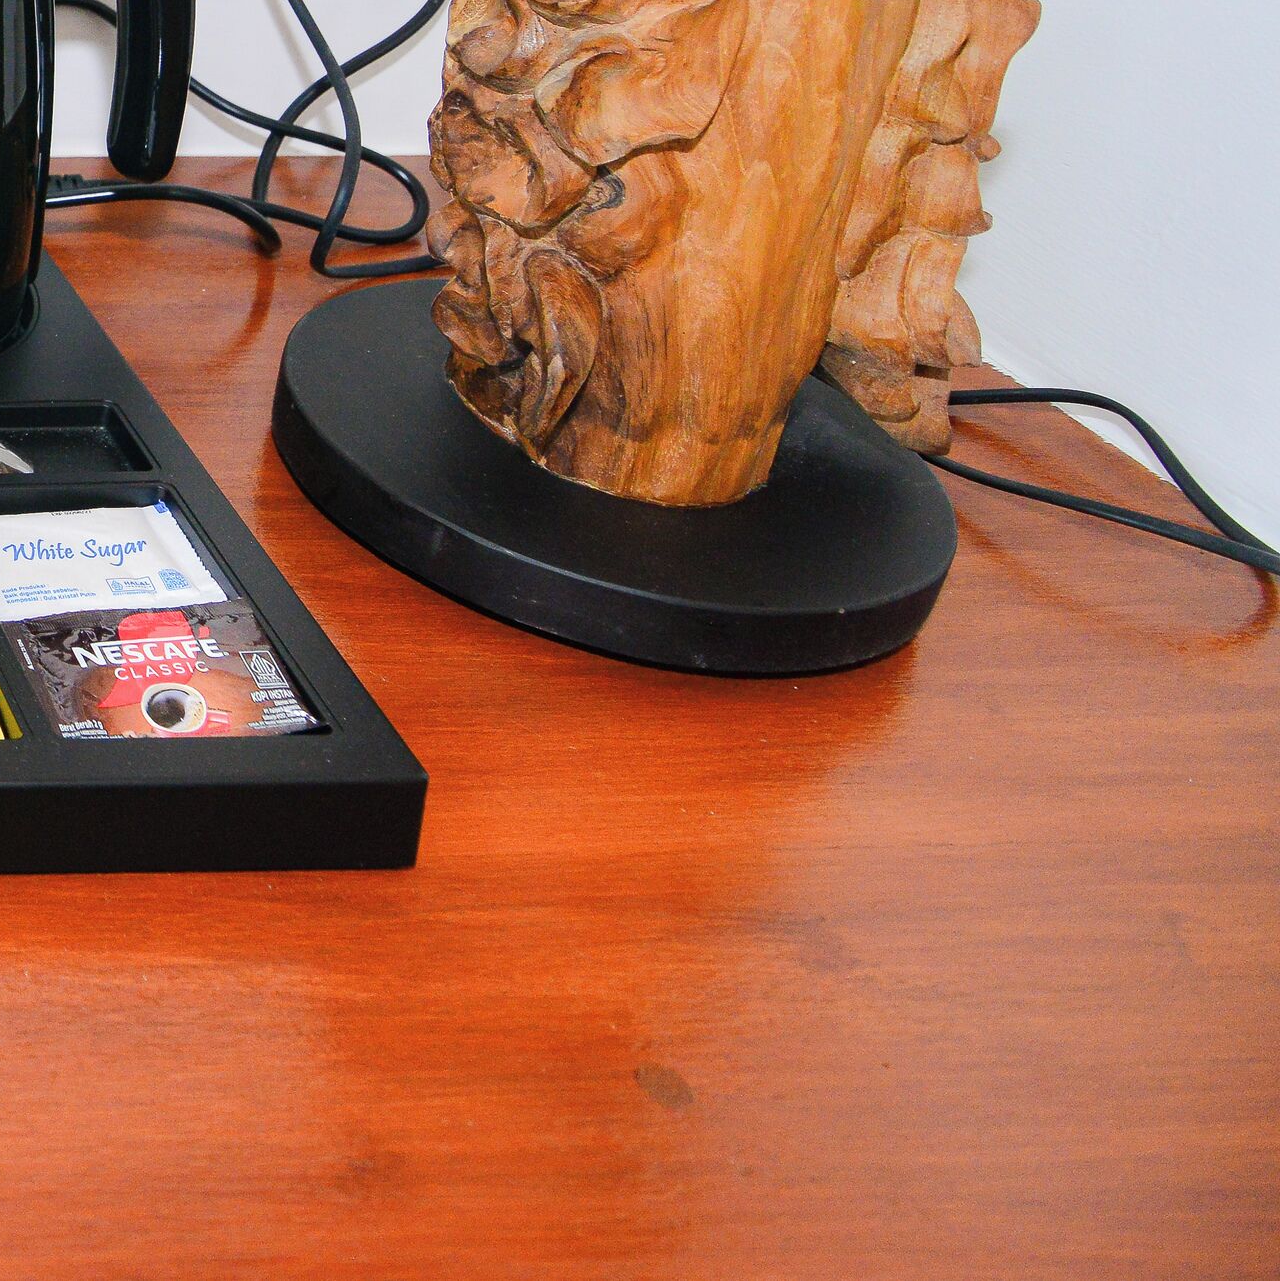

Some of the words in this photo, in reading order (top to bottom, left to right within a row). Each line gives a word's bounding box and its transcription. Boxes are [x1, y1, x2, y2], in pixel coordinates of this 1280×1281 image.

[2, 538, 75, 561] White
[80, 538, 147, 567] Sugar
[114, 660, 209, 680] CLASSIC
[250, 690, 269, 703] KOPI
